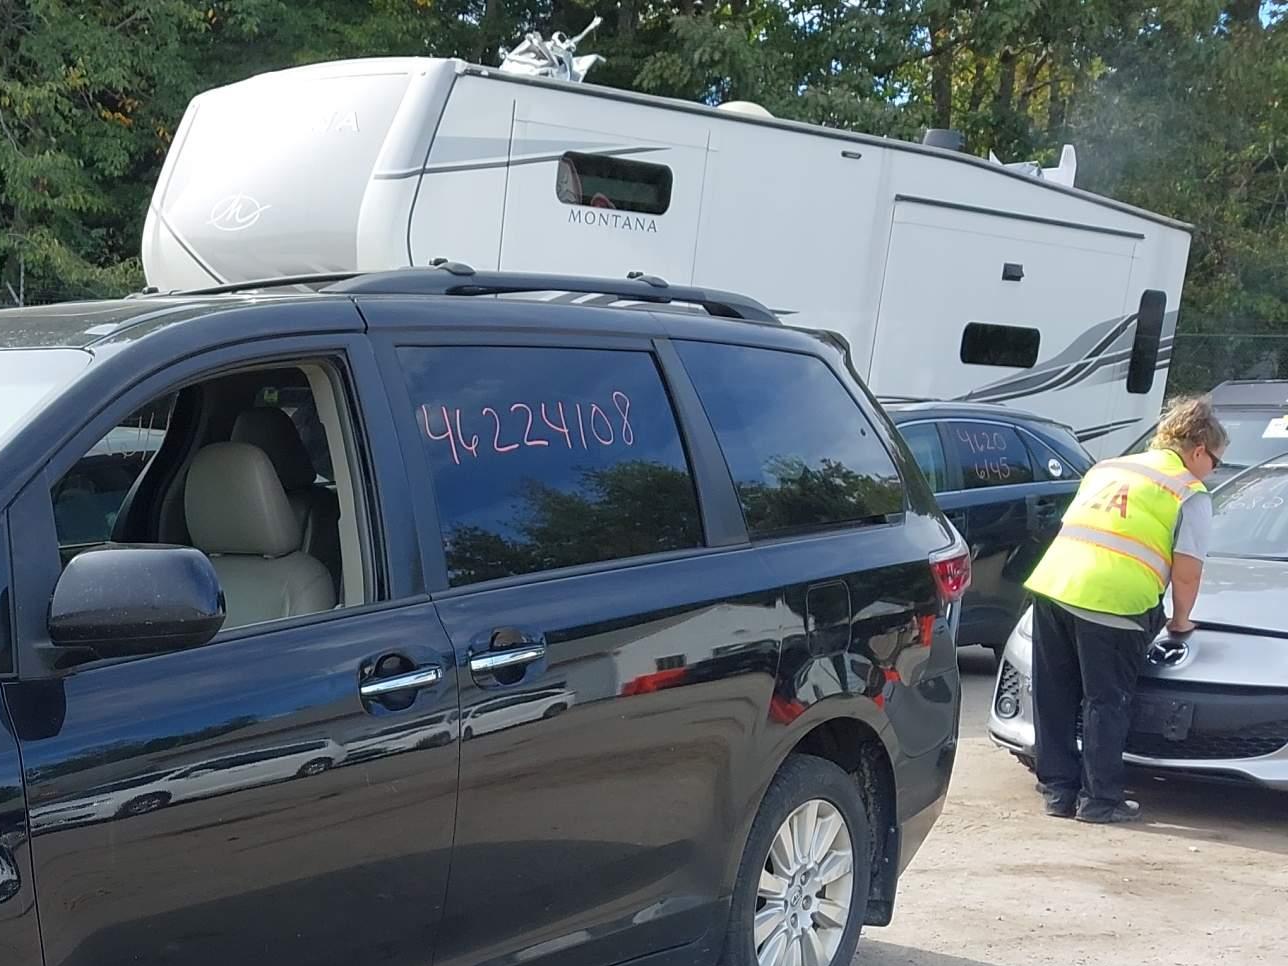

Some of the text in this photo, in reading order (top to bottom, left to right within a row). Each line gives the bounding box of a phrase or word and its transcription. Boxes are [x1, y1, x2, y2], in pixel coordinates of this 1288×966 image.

[568, 208, 658, 233] MONTANA
[422, 391, 634, 465] 46224108
[956, 428, 1008, 454] 4620
[975, 456, 1011, 480] 6145
